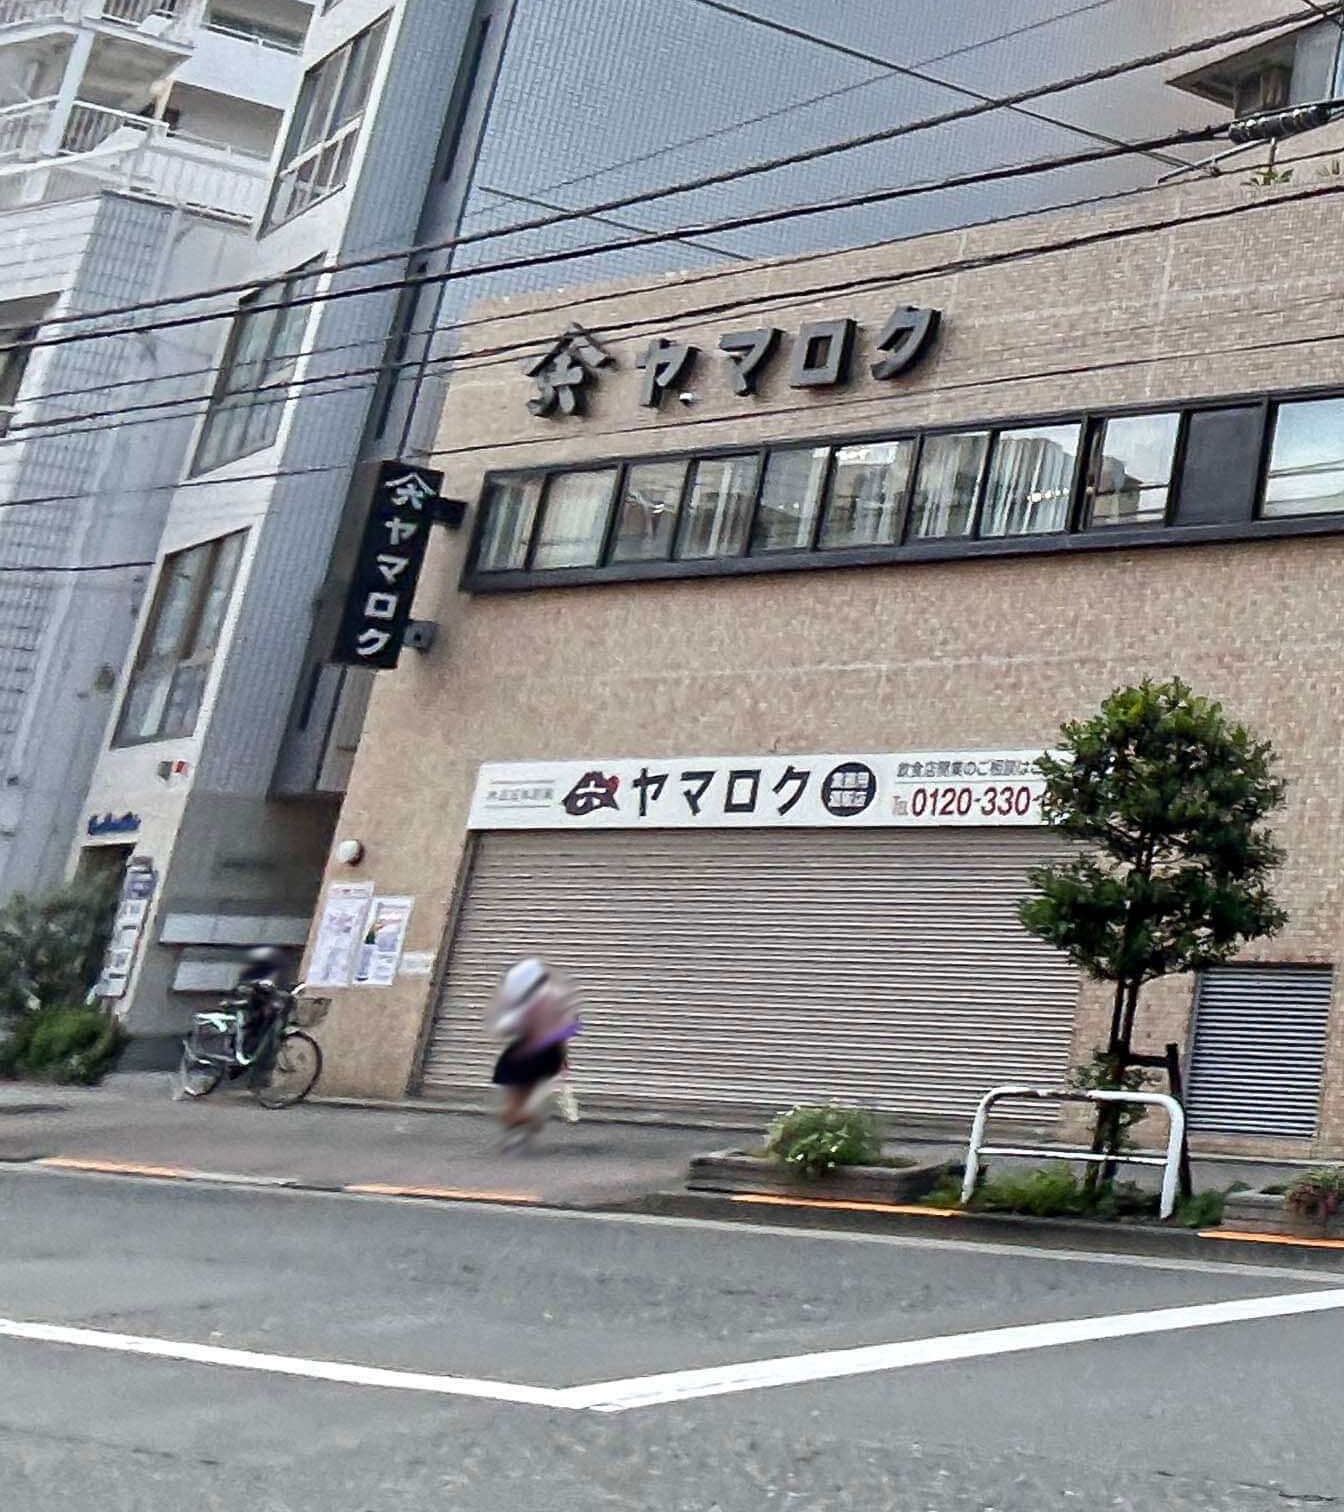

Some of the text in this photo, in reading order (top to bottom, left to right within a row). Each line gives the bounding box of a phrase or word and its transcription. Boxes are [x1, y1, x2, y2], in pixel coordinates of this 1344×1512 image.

[637, 305, 942, 408] ヤマロク
[354, 516, 419, 657] ヤマロク
[631, 765, 811, 818] ヤマロク
